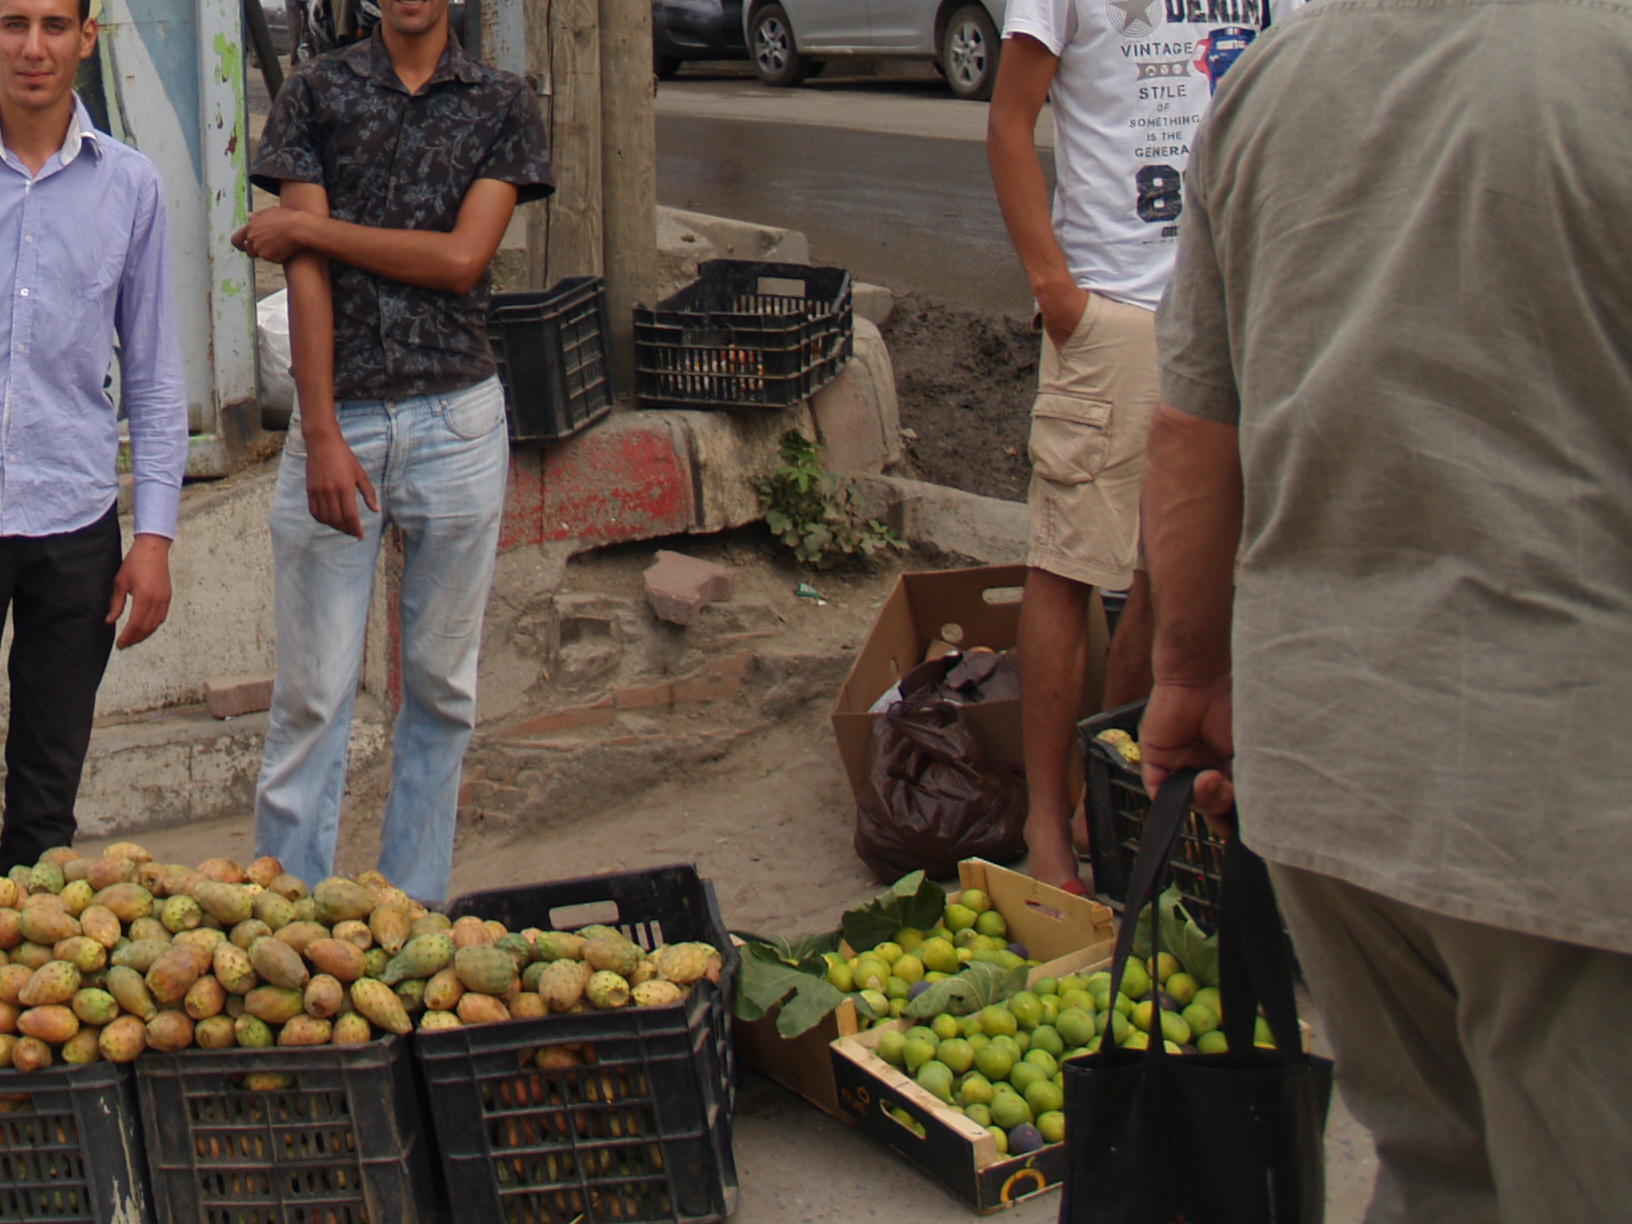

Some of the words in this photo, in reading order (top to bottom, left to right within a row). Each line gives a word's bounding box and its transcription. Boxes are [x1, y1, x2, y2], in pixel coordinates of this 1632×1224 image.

[1121, 42, 1194, 57] VINTAGE
[1157, 102, 1171, 112] OF
[1130, 115, 1200, 128] SOMETHING
[1147, 132, 1157, 142] IS
[1162, 131, 1183, 141] THE
[1135, 144, 1191, 157] GENERA
[1135, 164, 1186, 223] 8
